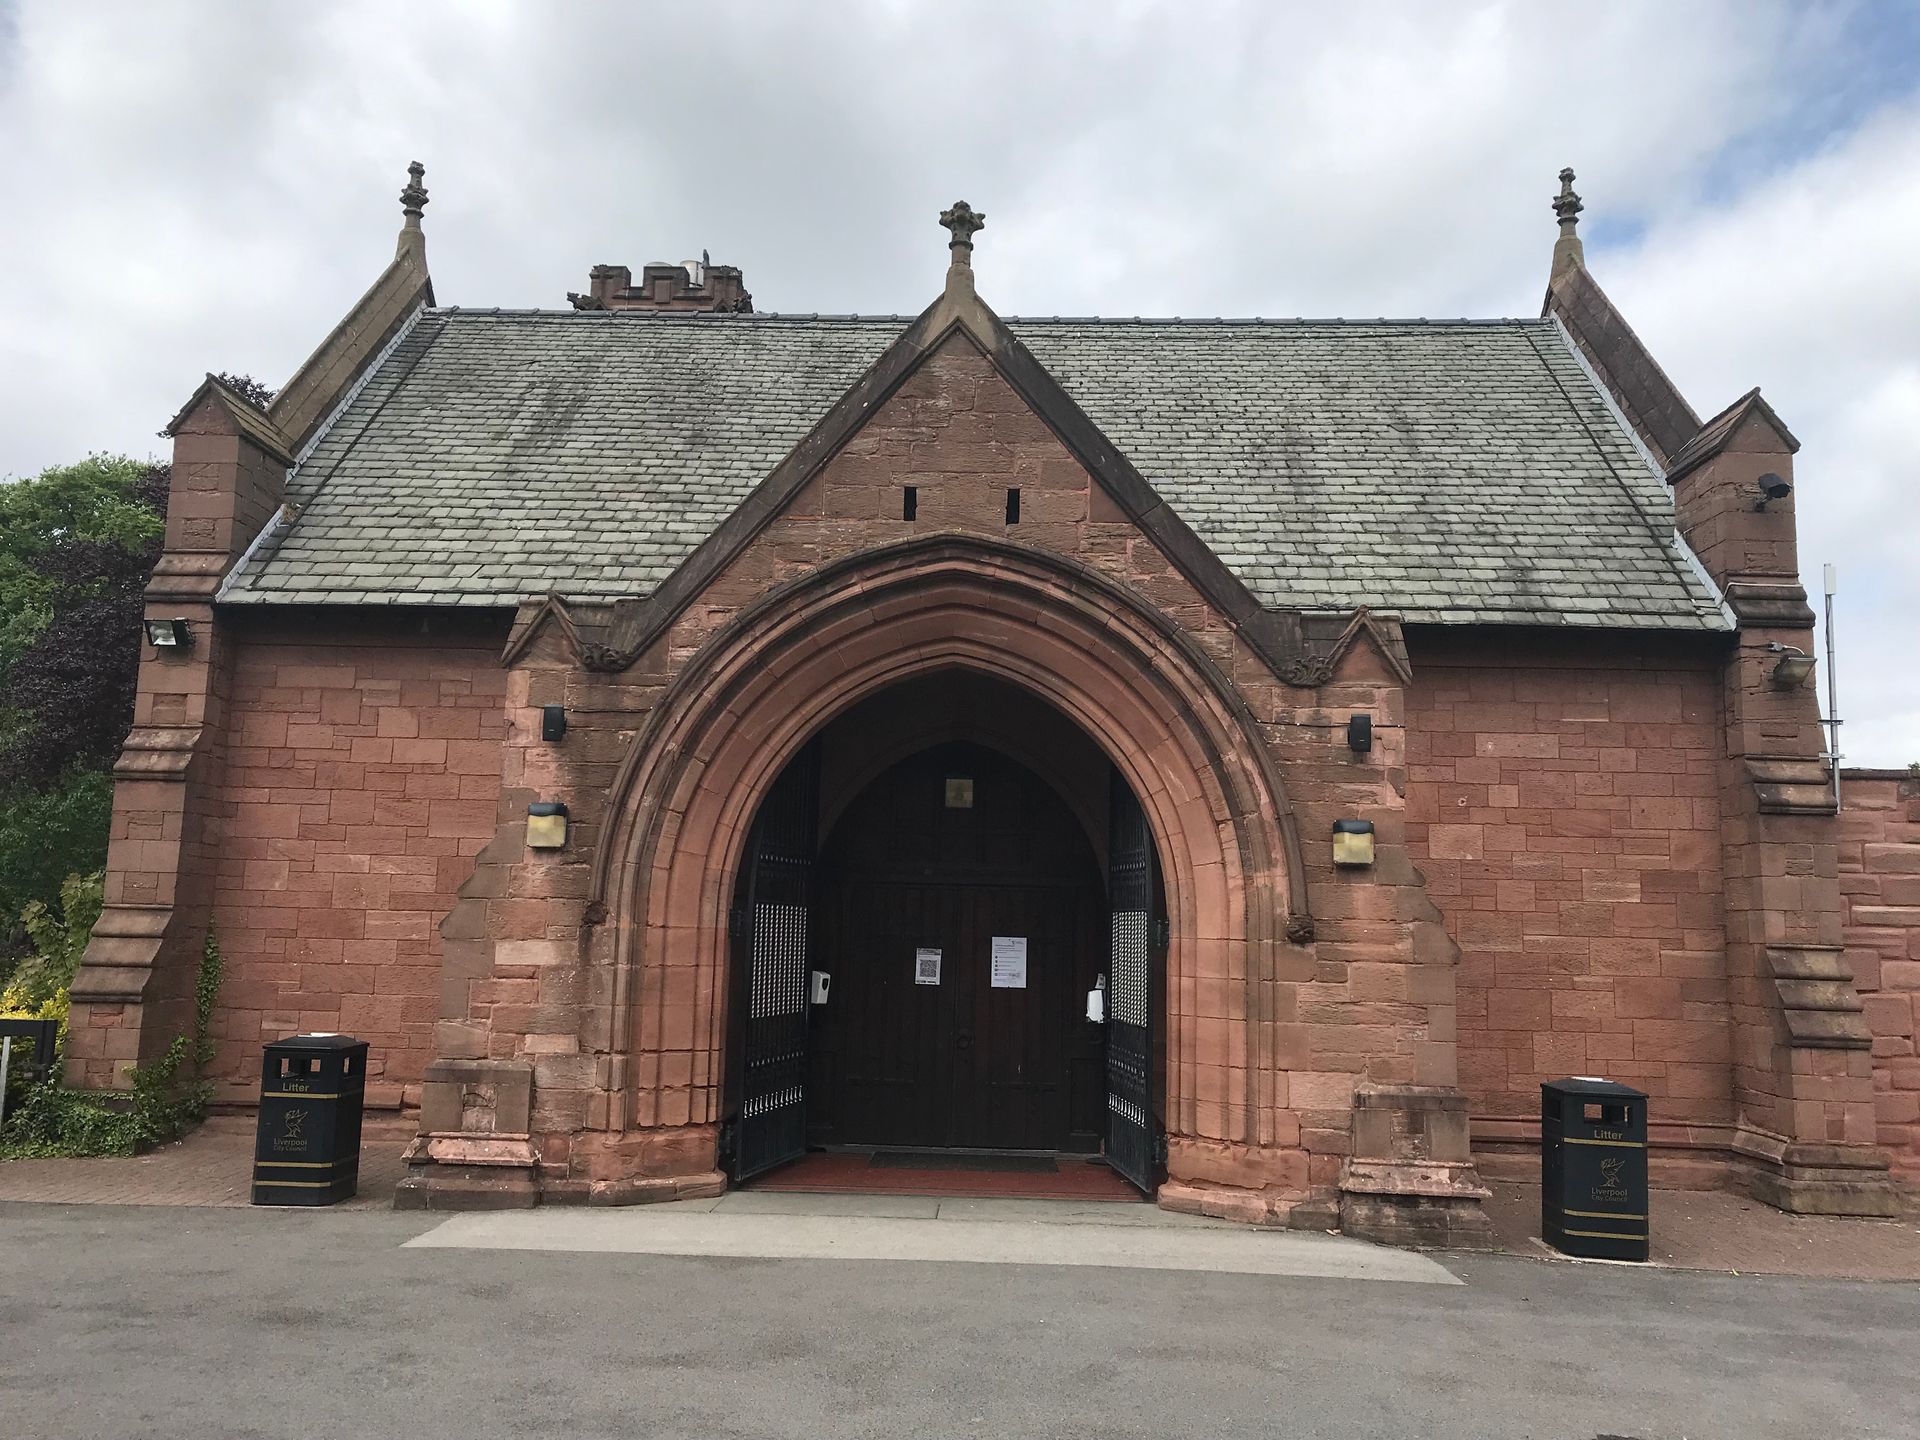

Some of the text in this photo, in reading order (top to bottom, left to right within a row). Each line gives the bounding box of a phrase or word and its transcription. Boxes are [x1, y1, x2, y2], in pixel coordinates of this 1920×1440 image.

[282, 1082, 310, 1092] Litter
[1594, 1129, 1623, 1140] Litter
[273, 1138, 308, 1148] Liverpool
[1591, 1187, 1628, 1197] Liverpool
